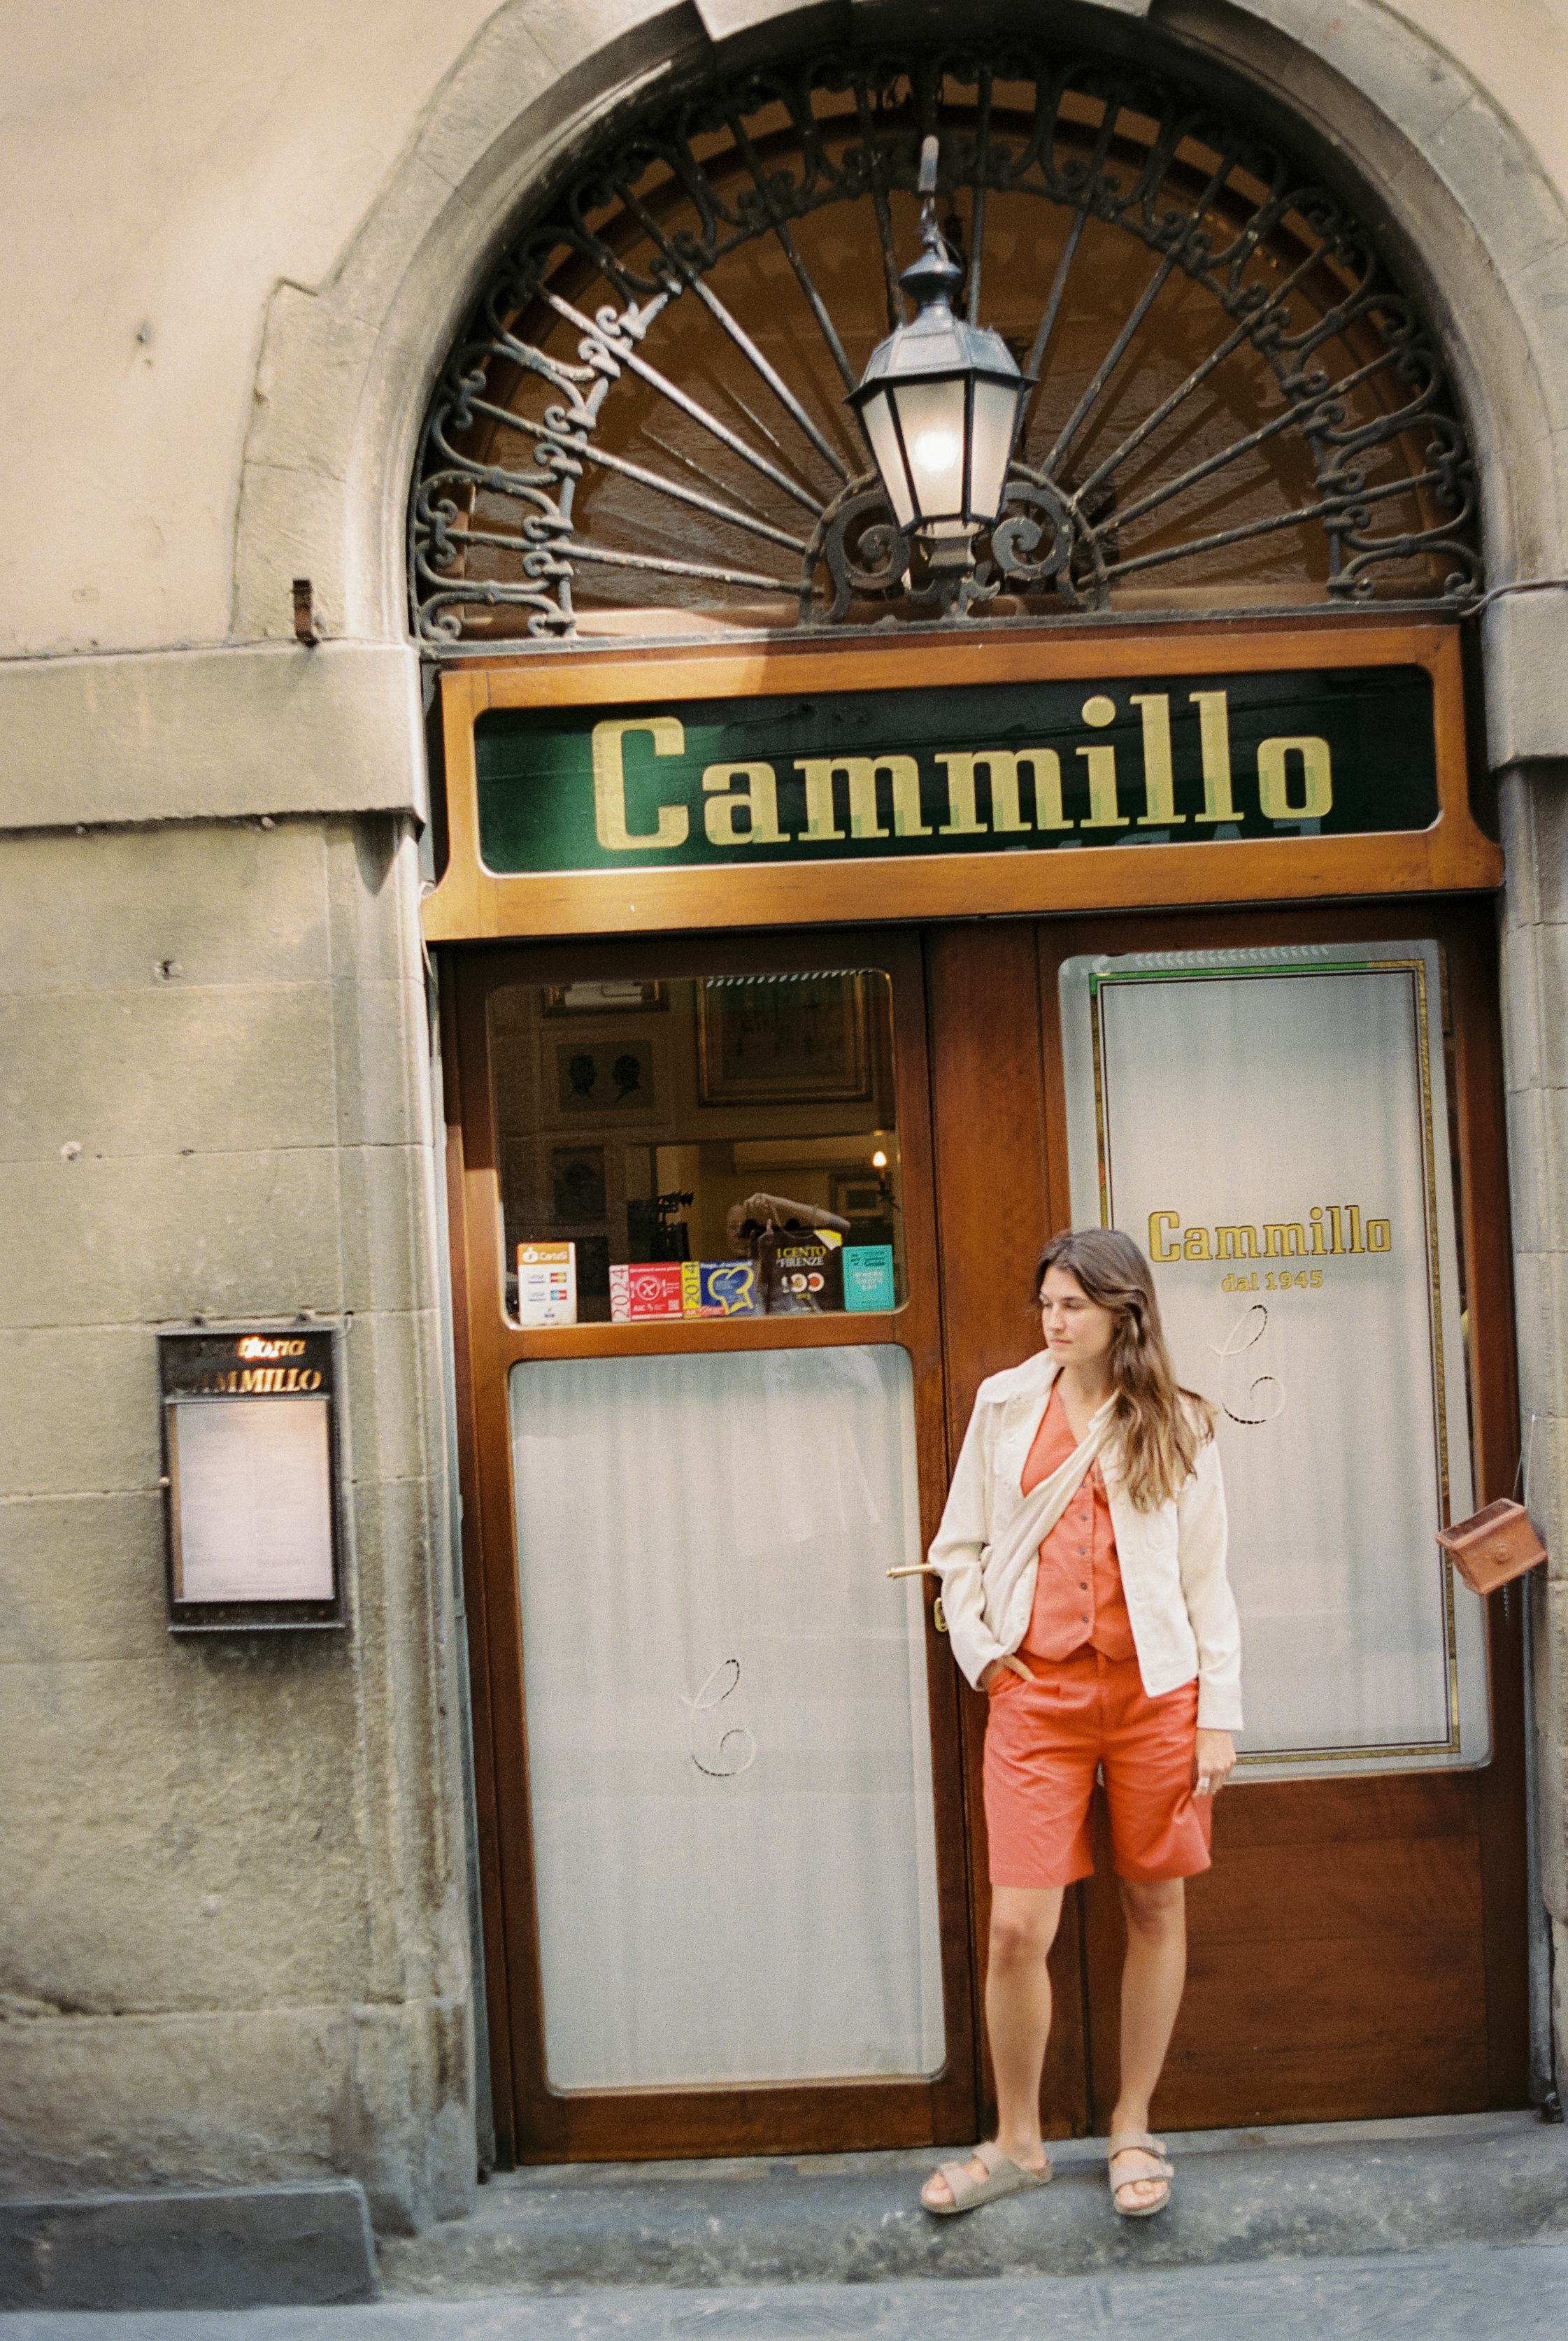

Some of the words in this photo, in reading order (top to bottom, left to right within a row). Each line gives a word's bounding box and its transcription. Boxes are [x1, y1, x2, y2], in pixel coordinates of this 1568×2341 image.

[590, 690, 1334, 852] Cammillo
[1148, 1204, 1392, 1263] Cammillo
[611, 1269, 629, 1318] 2024
[1222, 1272, 1258, 1293] dal
[1266, 1269, 1324, 1291] 1945
